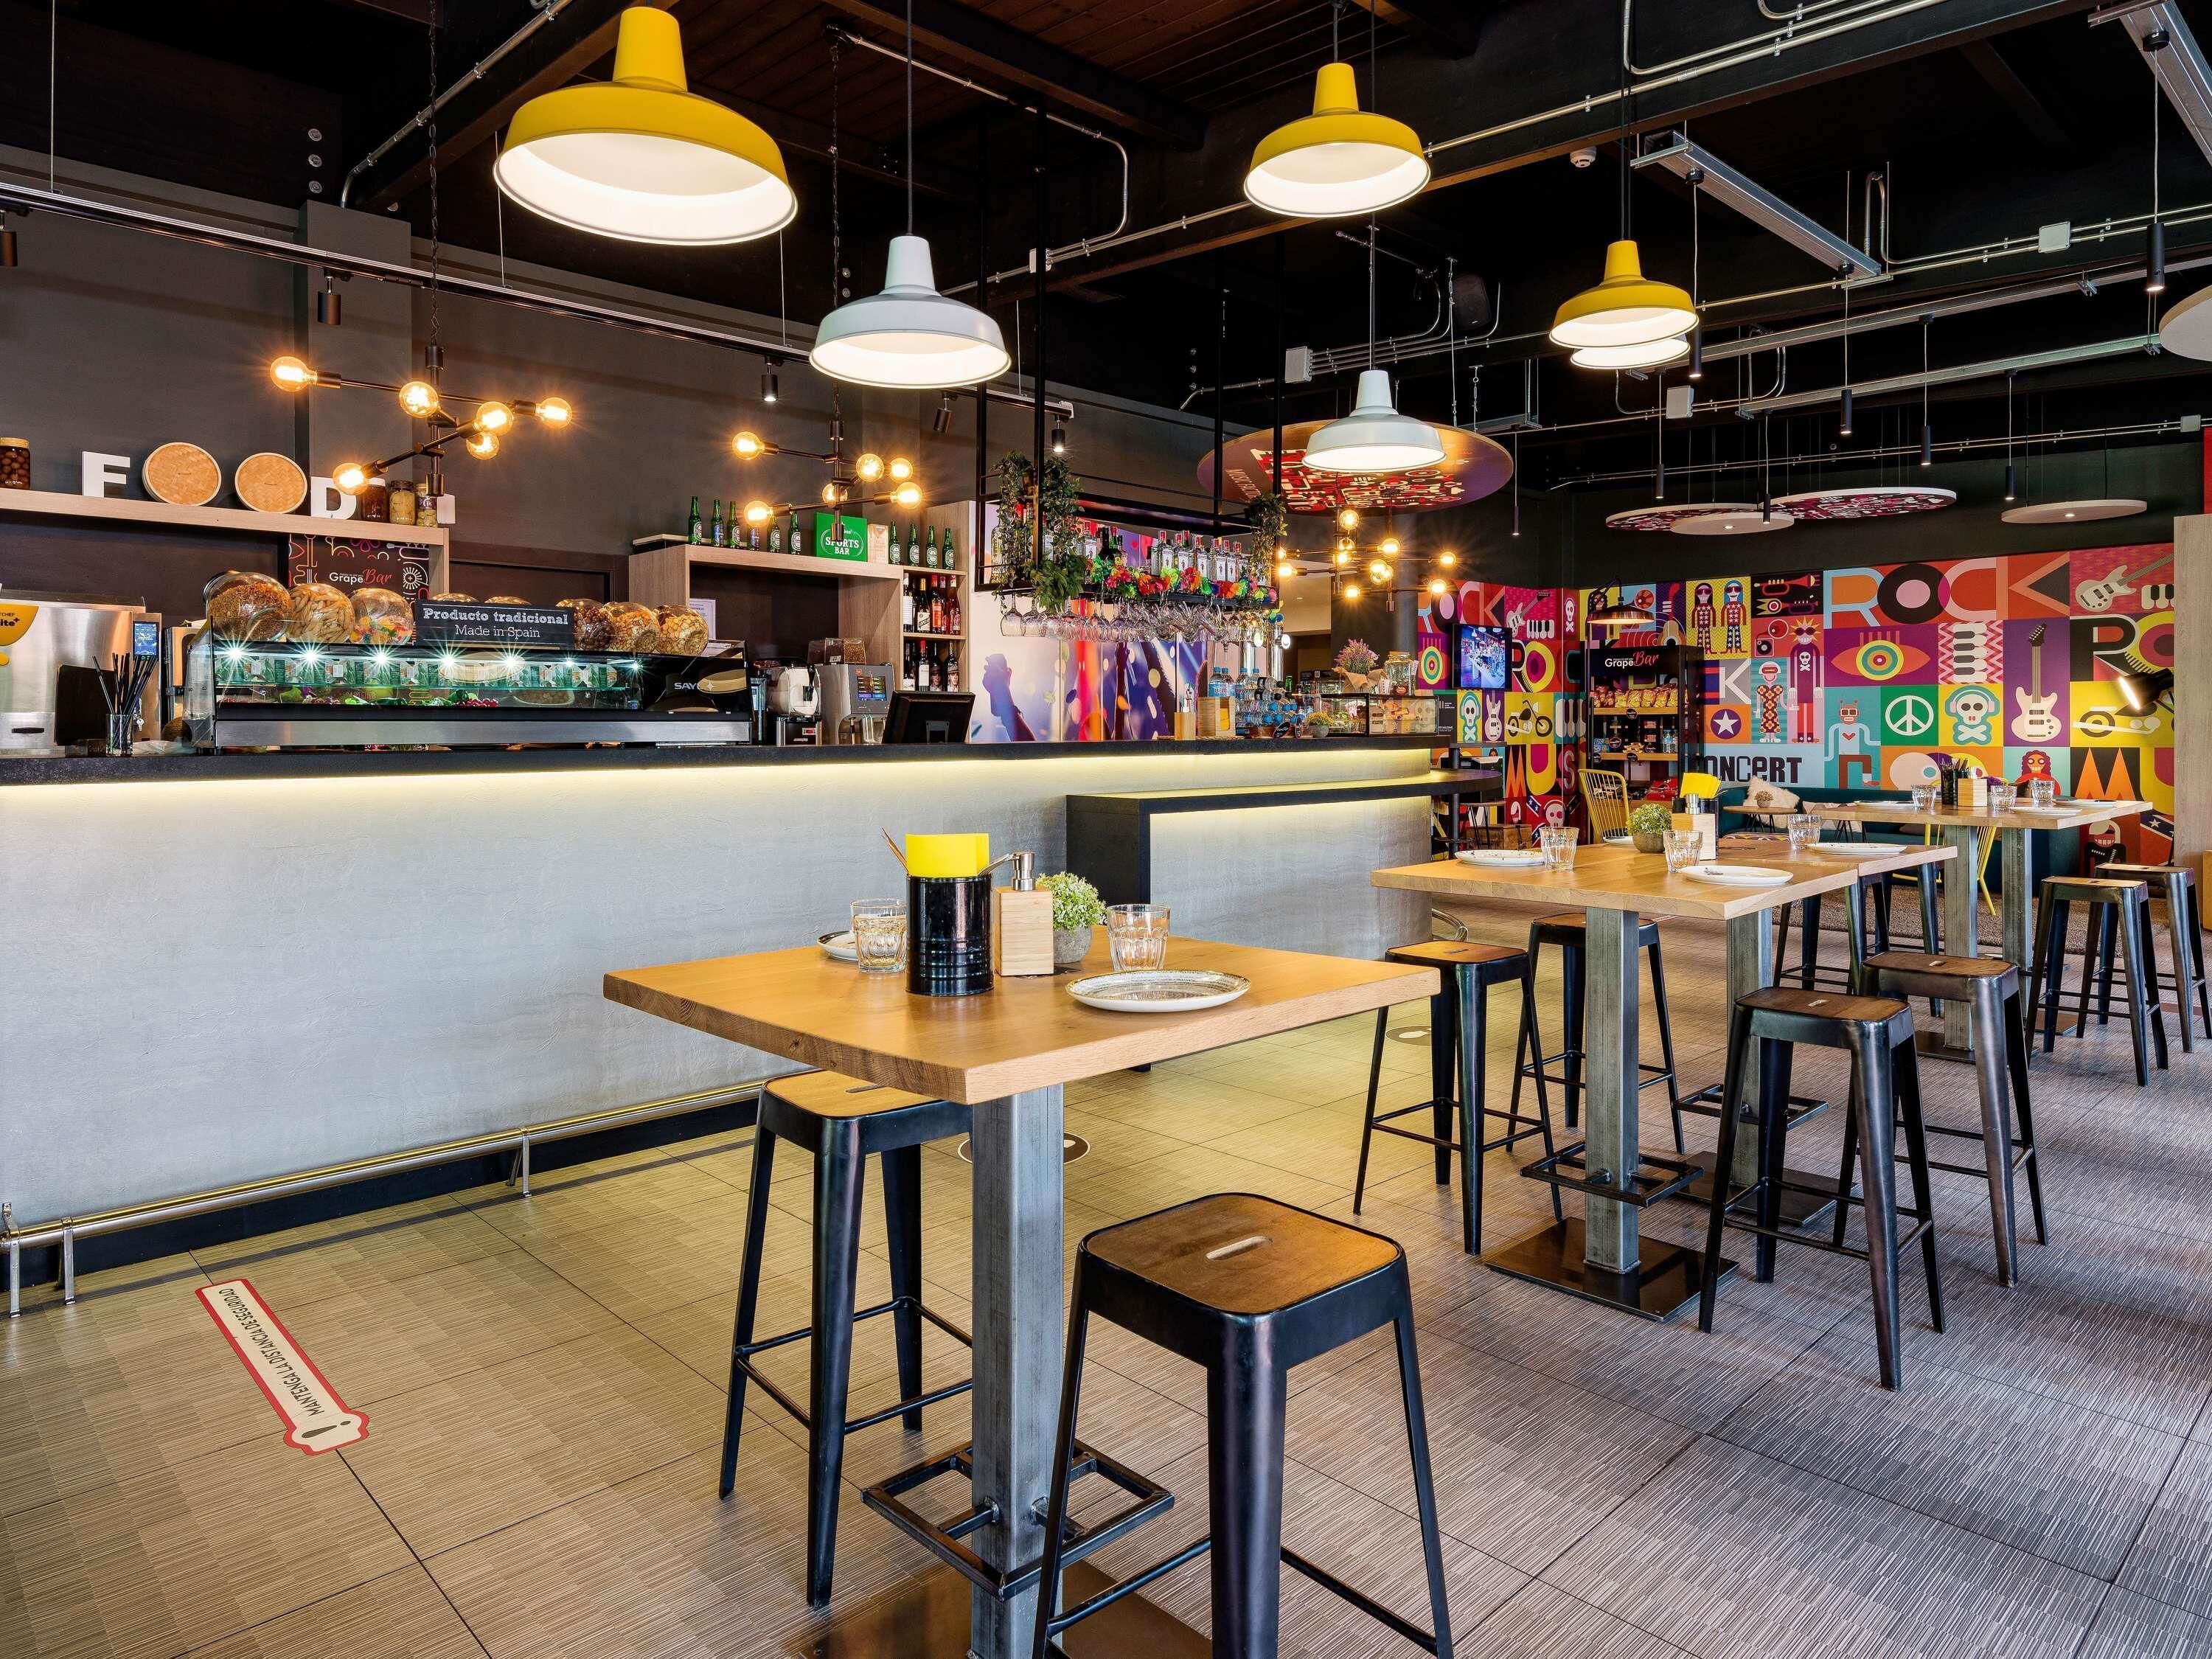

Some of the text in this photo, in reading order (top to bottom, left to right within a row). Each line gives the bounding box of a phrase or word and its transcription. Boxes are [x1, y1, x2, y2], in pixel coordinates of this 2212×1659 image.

[826, 537, 859, 549] SPORTS
[835, 546, 849, 554] BAR
[330, 567, 392, 585] Grape Bar
[423, 608, 568, 625] Producto tradicional
[455, 625, 540, 639] Made in Spain
[1605, 650, 1659, 669] Grape Bar
[674, 682, 699, 690] SAY
[219, 1288, 324, 1416] MANTENGA LA DISTANCIA DE SEGURIDAD
